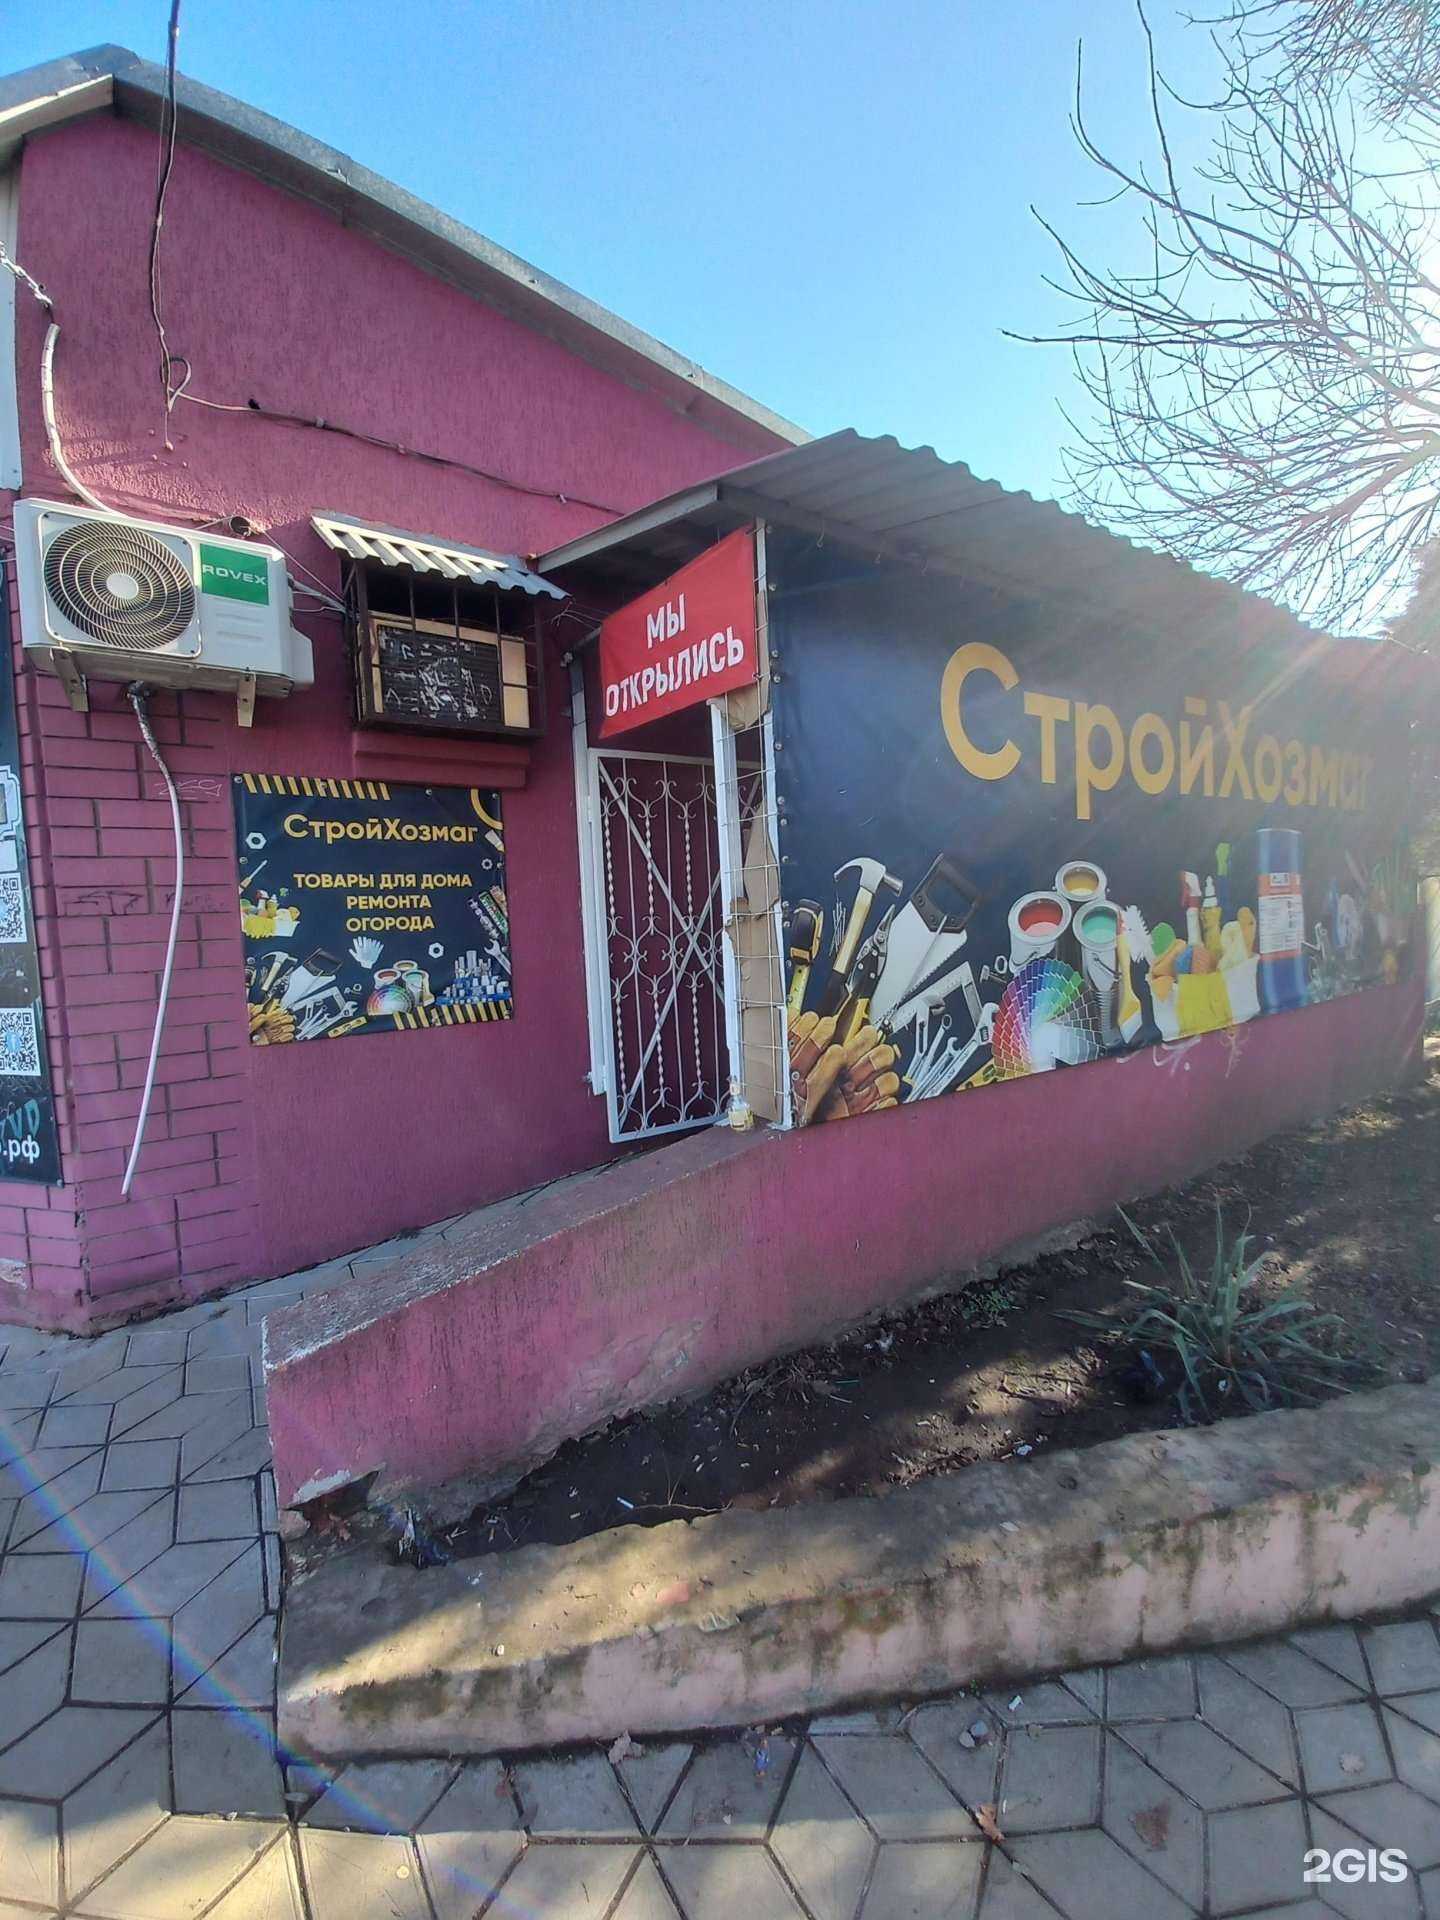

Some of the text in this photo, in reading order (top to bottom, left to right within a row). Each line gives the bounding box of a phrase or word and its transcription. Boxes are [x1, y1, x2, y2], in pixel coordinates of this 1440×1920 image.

[202, 564, 267, 585] ROVEX
[646, 593, 685, 649] МЫ
[605, 625, 744, 717] ОТКРЫЛИСЬ
[940, 641, 1376, 820] СтройХозмаг
[283, 813, 478, 845] СтройХозмаг
[293, 873, 473, 890] ТОВАРЫ ДЛЯ ДОМА
[346, 894, 432, 910] РЕМОНТА
[346, 915, 435, 932] ОГОРОДА
